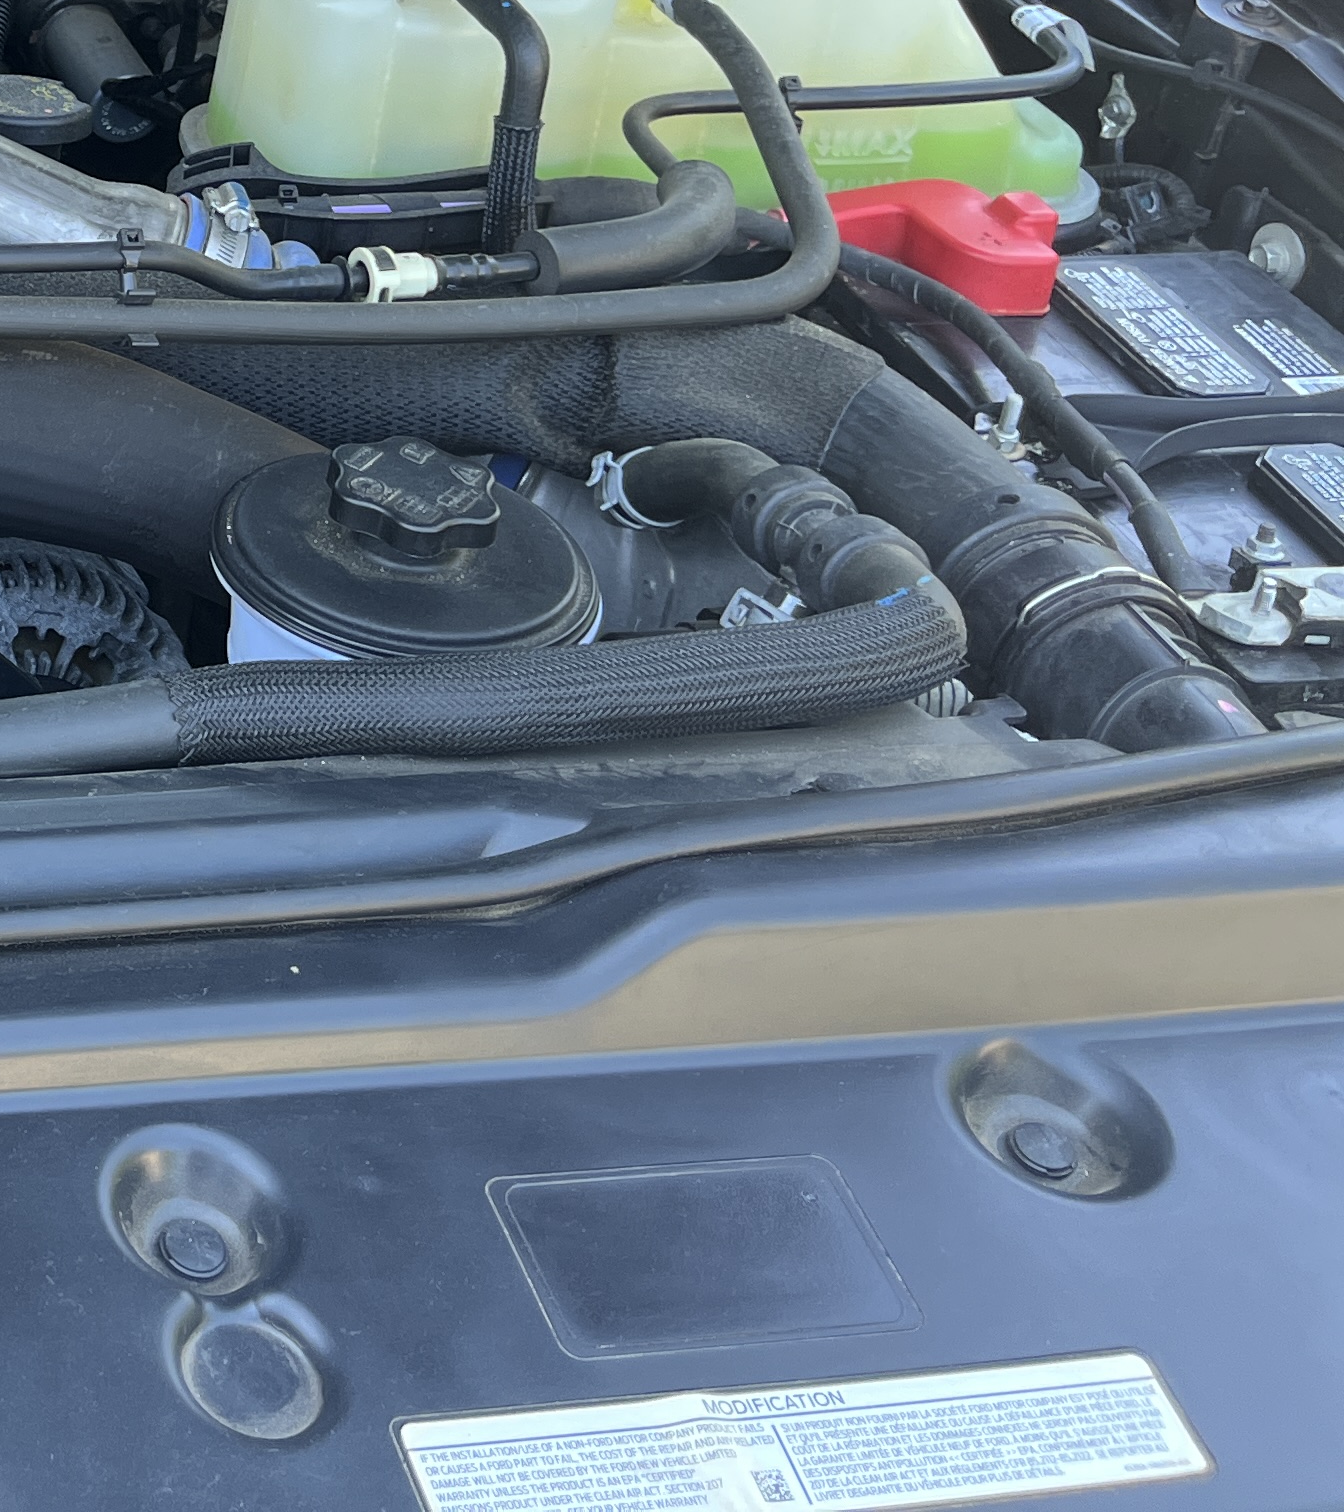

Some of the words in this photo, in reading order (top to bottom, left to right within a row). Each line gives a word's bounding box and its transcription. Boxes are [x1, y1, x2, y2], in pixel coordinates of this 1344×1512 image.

[844, 1416, 867, 1427] NON
[899, 1410, 920, 1422] PAR
[920, 1409, 932, 1419] LA
[968, 1403, 994, 1414] FORD
[993, 1399, 1026, 1411] MOTOR
[431, 1451, 450, 1462] THE
[541, 1441, 554, 1451] OF
[616, 1432, 649, 1445] MOTOR
[649, 1426, 696, 1442] COMPANY
[696, 1422, 737, 1436] PRODUCT
[738, 1422, 765, 1434] FAILS
[786, 1434, 799, 1445] ET
[963, 1414, 993, 1426] CAUSE
[992, 1413, 1005, 1423] LA
[830, 1441, 844, 1452] LA
[913, 1432, 932, 1444] LES
[425, 1466, 440, 1477] OR
[441, 1462, 478, 1475] CAUSES
[487, 1458, 513, 1471] FORD
[514, 1456, 540, 1468] PART
[540, 1455, 555, 1466] TO
[579, 1451, 599, 1462] THE
[599, 1447, 624, 1460] COST
[625, 1446, 638, 1457] OF
[639, 1444, 658, 1456] THE
[658, 1439, 693, 1454] REPAIR
[694, 1436, 716, 1450] AND
[716, 1435, 734, 1447] ANY
[734, 1434, 775, 1447] RELATED
[430, 1477, 472, 1490] DAMAGE
[472, 1474, 496, 1486] WILL
[496, 1472, 517, 1484] NOT
[518, 1471, 532, 1482] BE
[532, 1467, 576, 1480] COVERED
[576, 1465, 590, 1476] BY
[590, 1463, 611, 1474] THE
[610, 1460, 637, 1473] FORD
[637, 1458, 660, 1470] NEW
[660, 1453, 701, 1468] VEHICLE
[700, 1448, 738, 1463] LIMITED
[797, 1456, 812, 1467] LA
[435, 1488, 490, 1503] WARRANTY
[492, 1484, 530, 1497] UNLESS
[530, 1482, 549, 1493] THE
[549, 1478, 595, 1492] PRODUCT
[596, 1476, 606, 1487] IS
[606, 1475, 621, 1486] AN
[621, 1473, 642, 1484] EPA
[802, 1468, 823, 1479] DES
[840, 1476, 854, 1487] LA
[899, 1469, 918, 1481] ACT
[494, 1497, 539, 1511] PRODUCT
[539, 1493, 572, 1507] UNDER
[572, 1492, 592, 1504] THE
[593, 1487, 625, 1501] CLEAN
[626, 1486, 643, 1498] AIR
[666, 1481, 705, 1495] SECTION
[705, 1478, 724, 1491] 207
[614, 1498, 655, 1512] VEHICLE
[654, 1494, 708, 1510] WARRANTY
